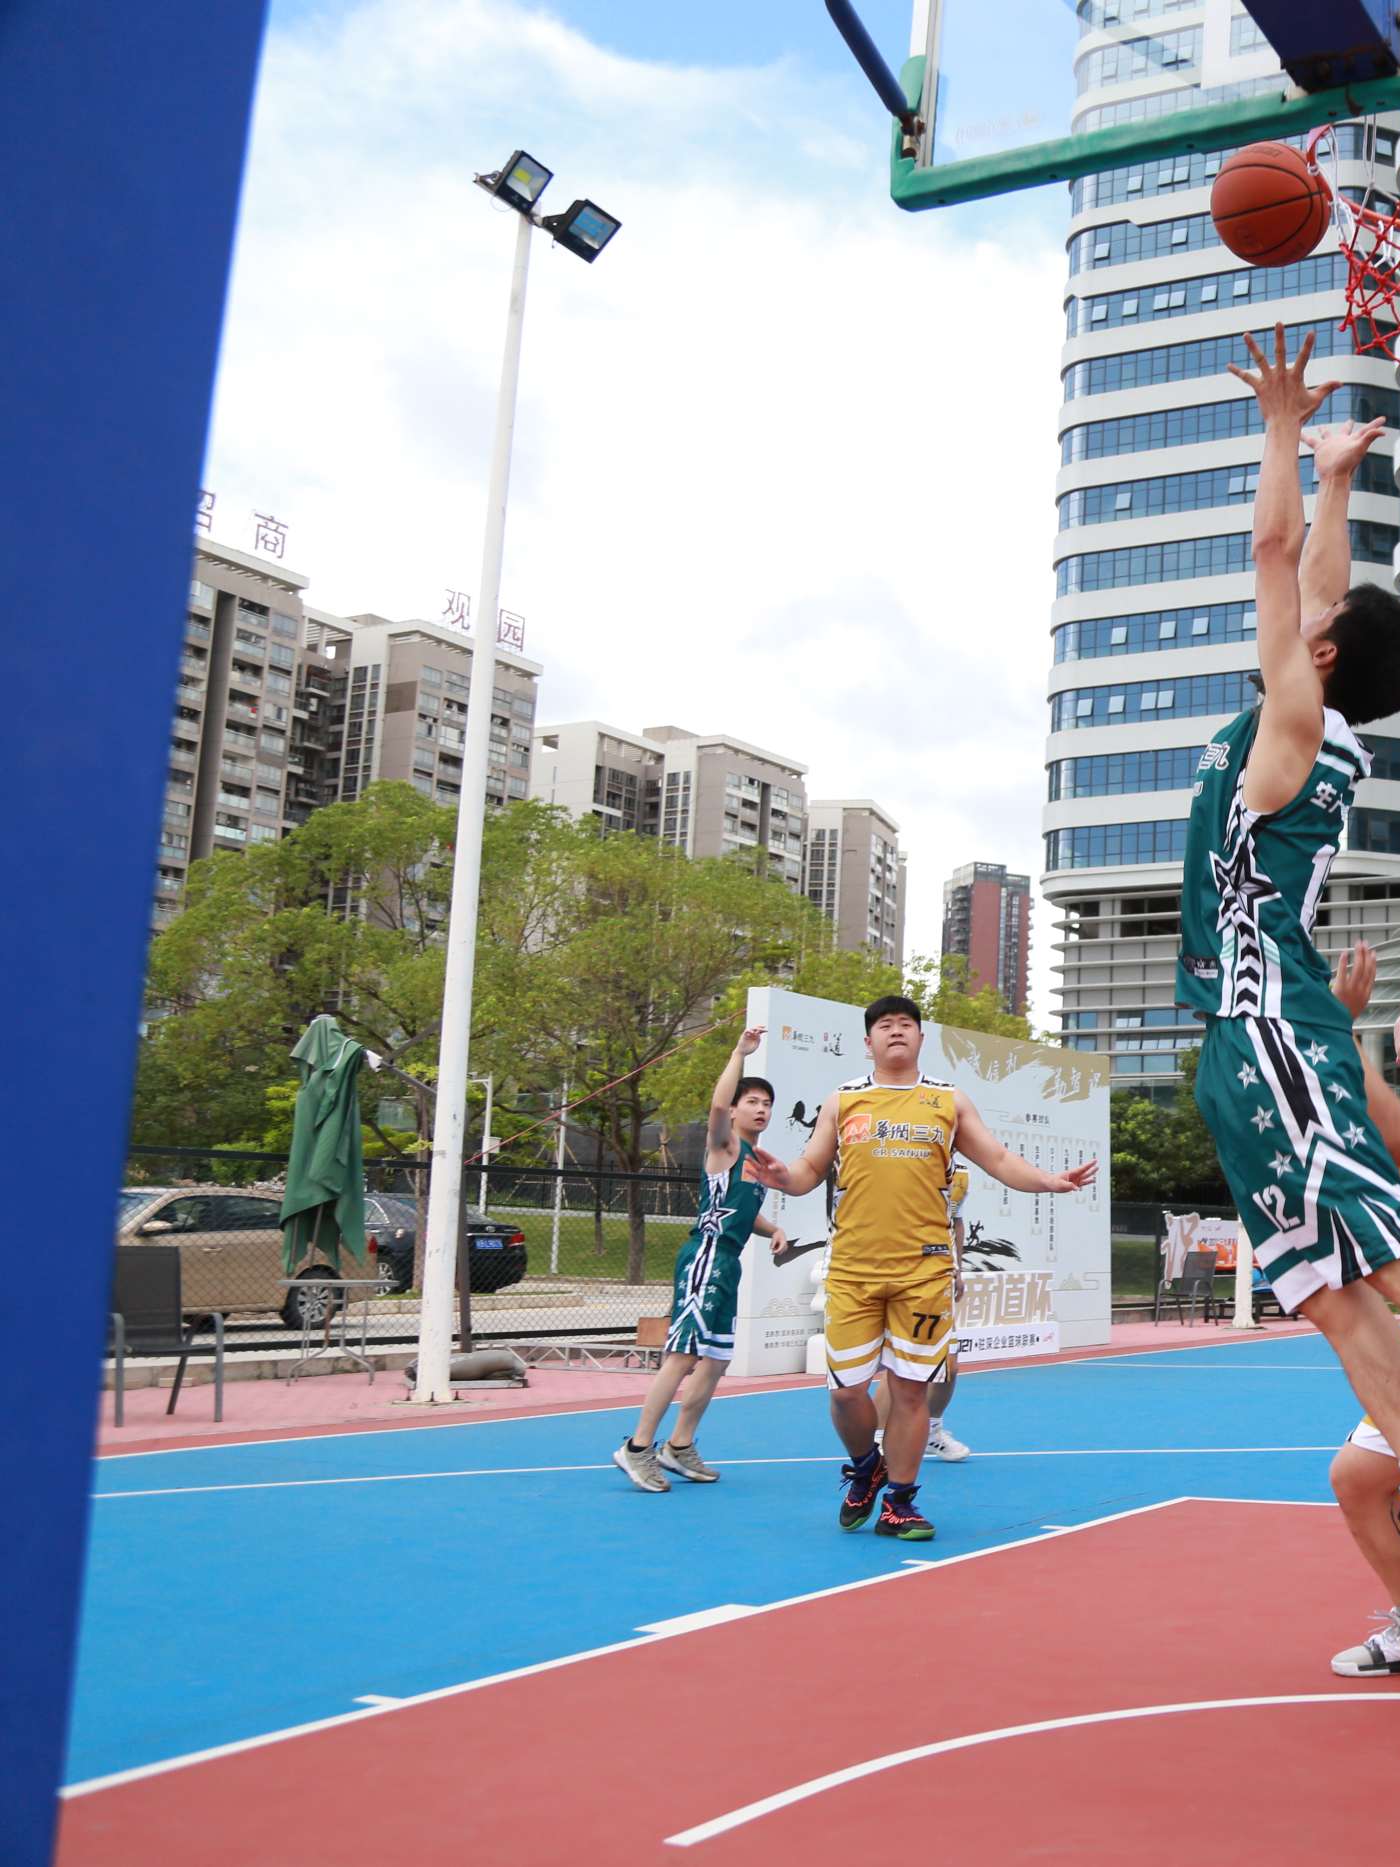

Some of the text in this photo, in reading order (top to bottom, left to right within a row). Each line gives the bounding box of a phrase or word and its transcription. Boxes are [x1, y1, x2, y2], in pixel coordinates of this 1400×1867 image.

[441, 588, 526, 652] 观园
[1199, 741, 1230, 770] 三九
[1252, 1184, 1301, 1232] 12
[912, 1312, 941, 1340] 77
